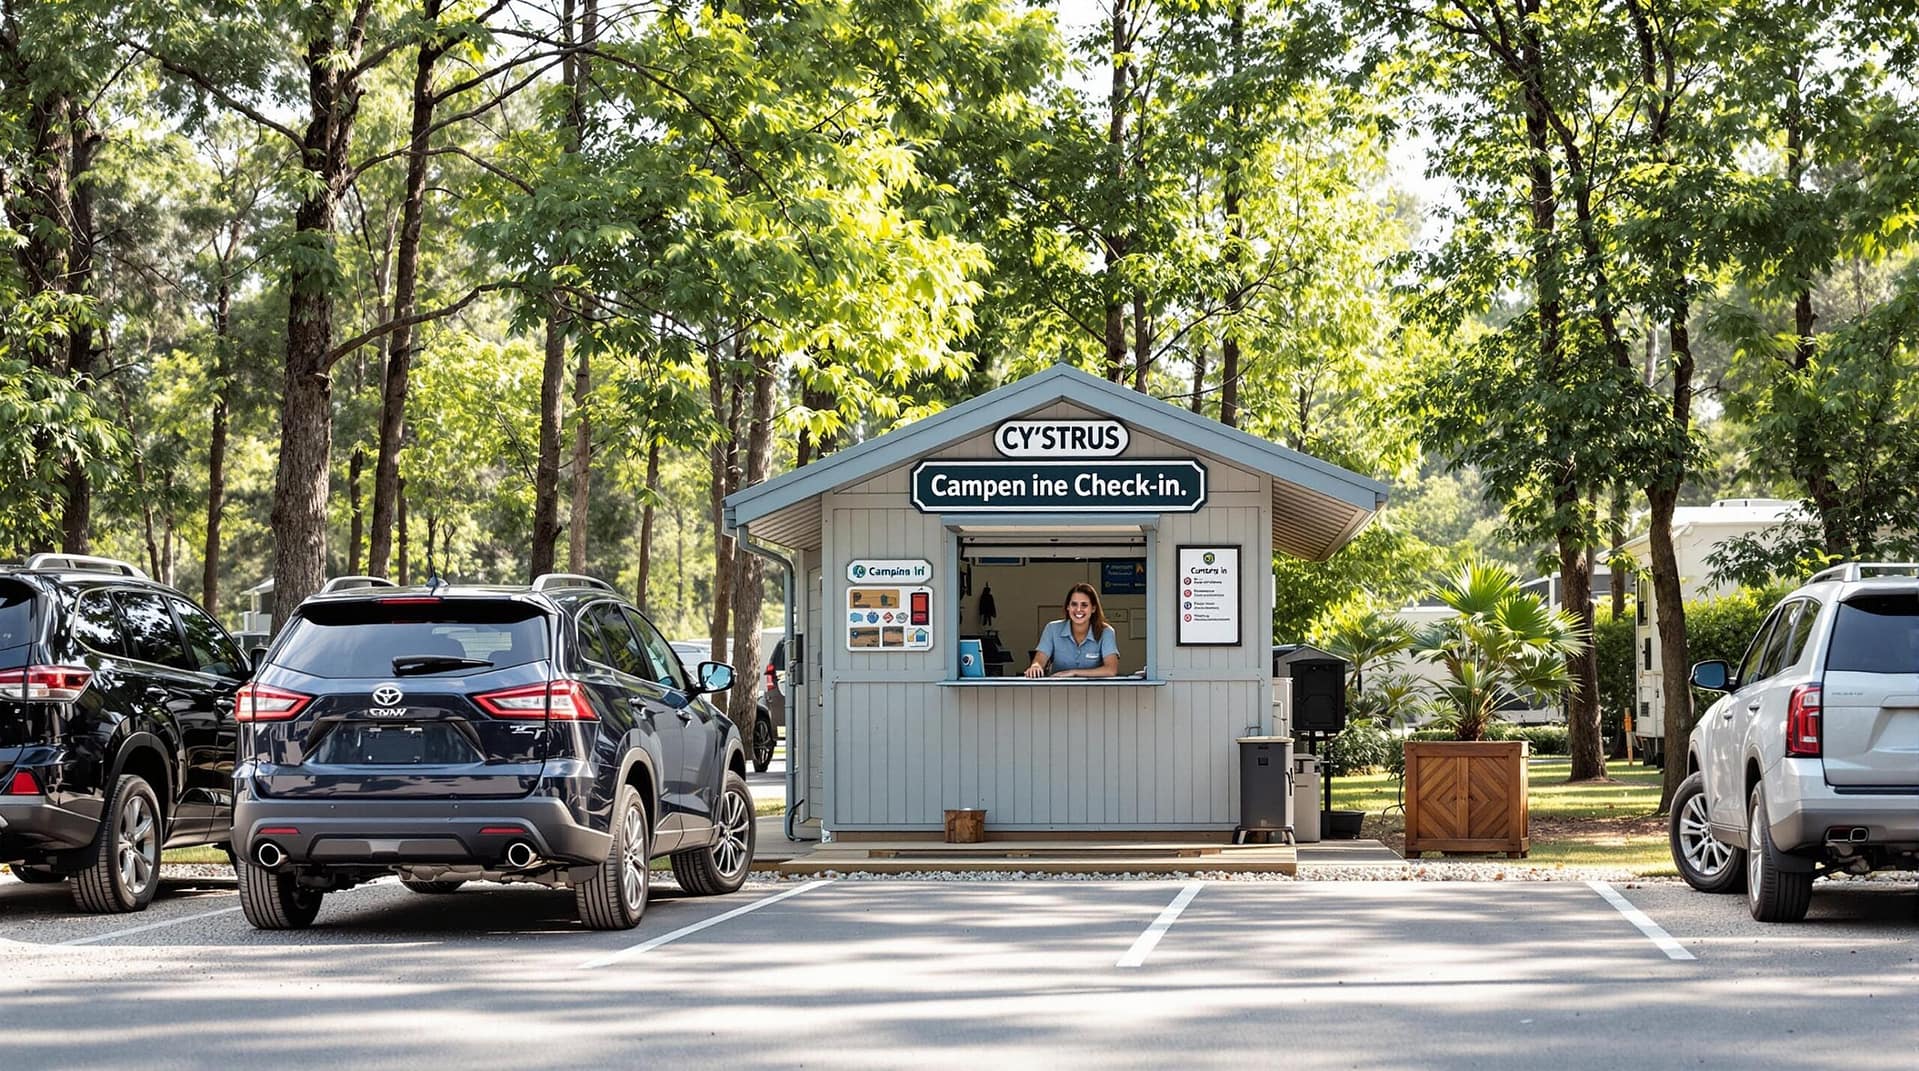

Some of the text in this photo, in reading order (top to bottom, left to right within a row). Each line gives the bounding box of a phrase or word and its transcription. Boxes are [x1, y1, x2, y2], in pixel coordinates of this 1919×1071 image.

[1002, 426, 1120, 449] CY'STRUS
[931, 474, 1187, 500] Campen ine Check-in.
